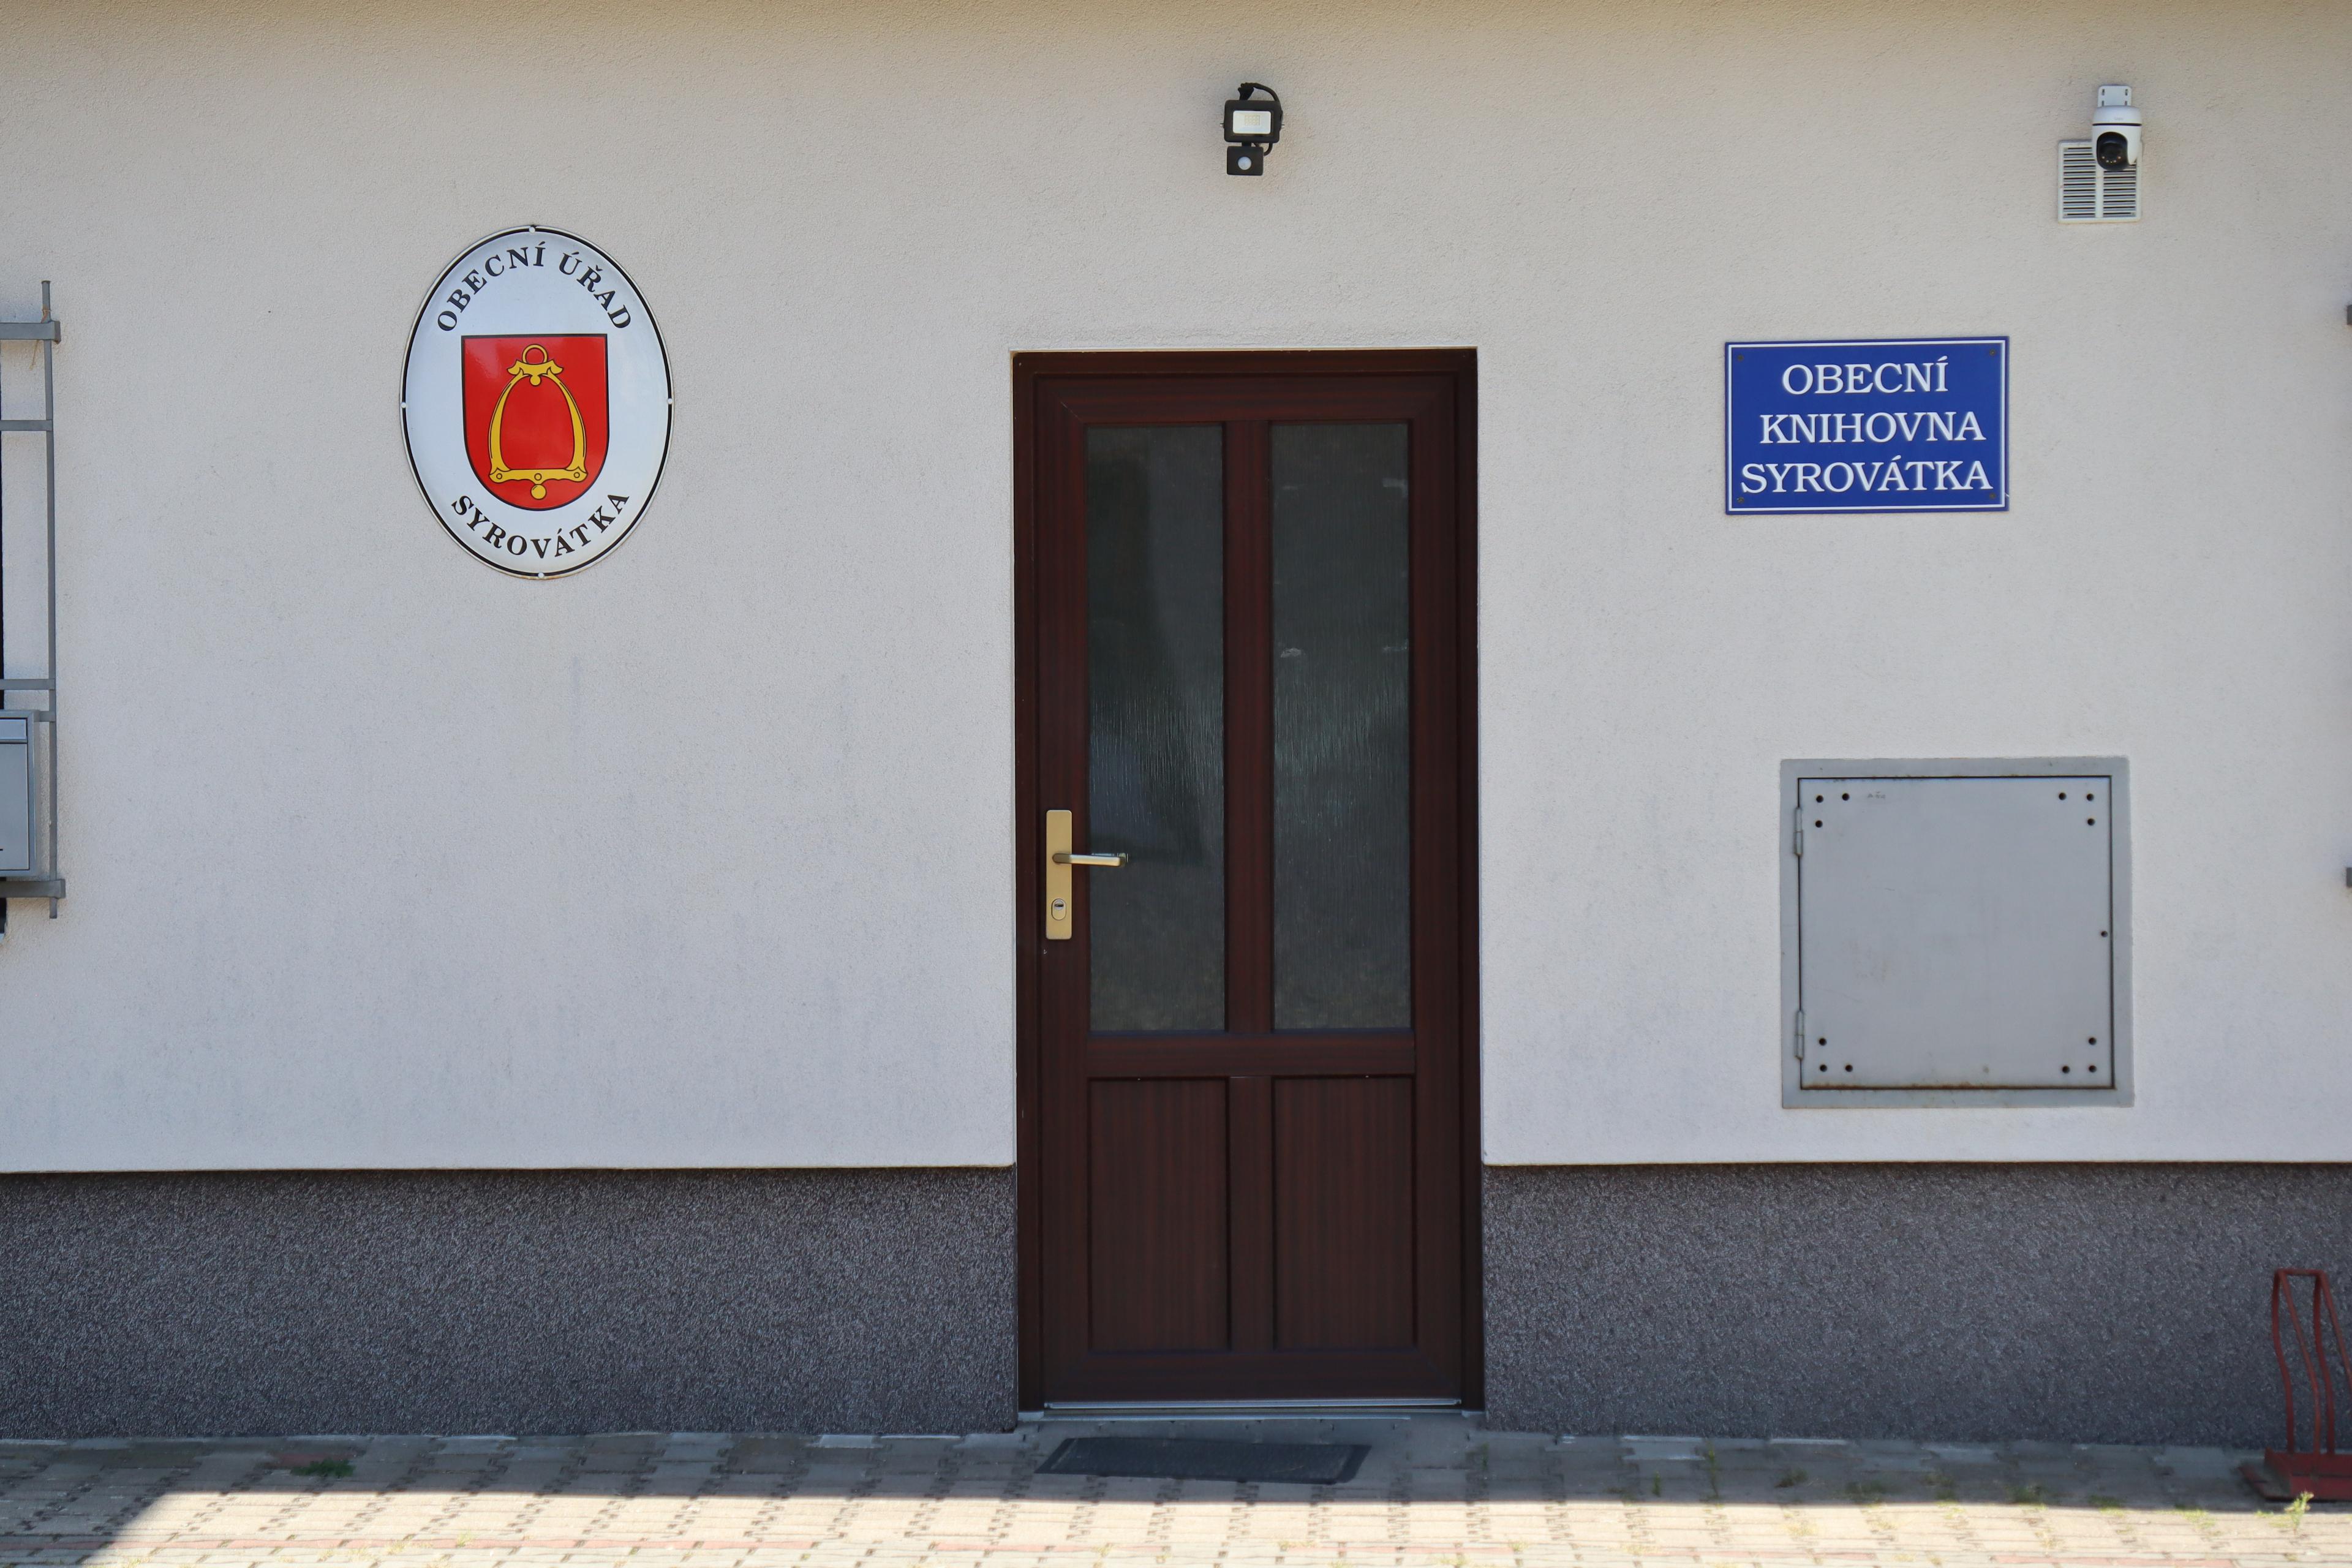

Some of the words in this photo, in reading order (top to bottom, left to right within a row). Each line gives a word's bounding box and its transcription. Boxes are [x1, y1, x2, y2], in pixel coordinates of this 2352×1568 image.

[437, 241, 546, 332] OBECNÍ
[558, 251, 631, 330] ÚŘAD
[1782, 355, 1948, 395] OBECNÍ
[1760, 411, 1986, 444] KNIHOVNA
[1741, 454, 1994, 494] SYROVÁTKA
[451, 492, 630, 559] SYROVÁTKA
